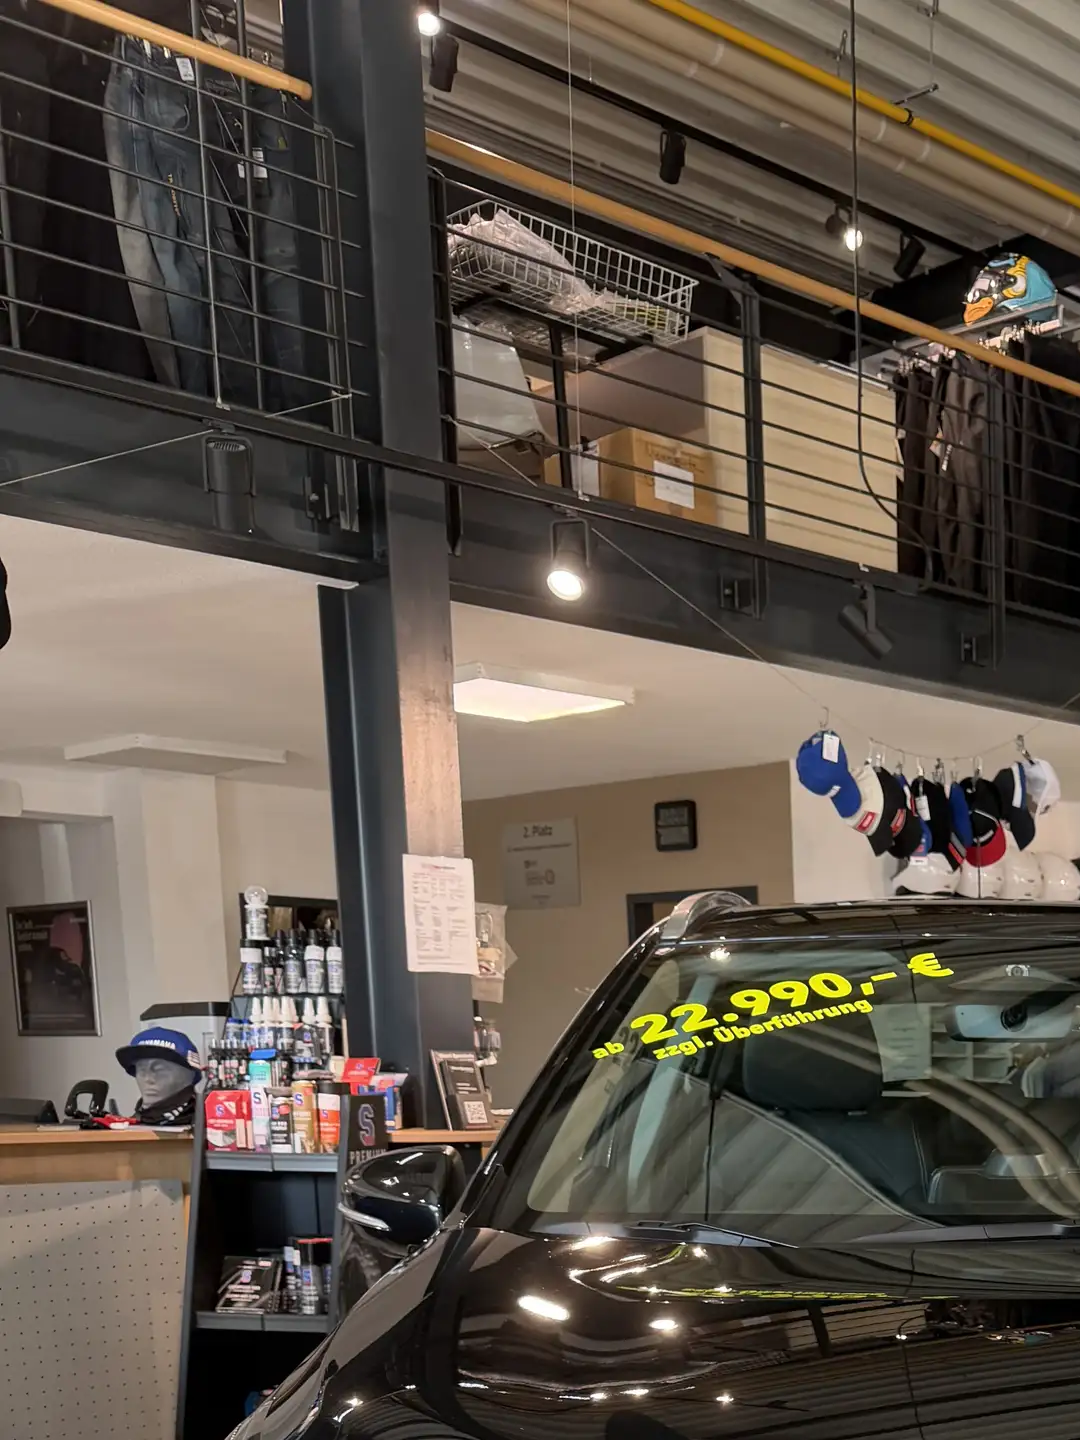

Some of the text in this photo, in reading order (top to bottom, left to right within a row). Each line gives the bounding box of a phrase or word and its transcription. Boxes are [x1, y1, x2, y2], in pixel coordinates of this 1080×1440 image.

[592, 952, 955, 1060] ab 22.990,- €
[653, 999, 874, 1060] zzgl. Überführung
